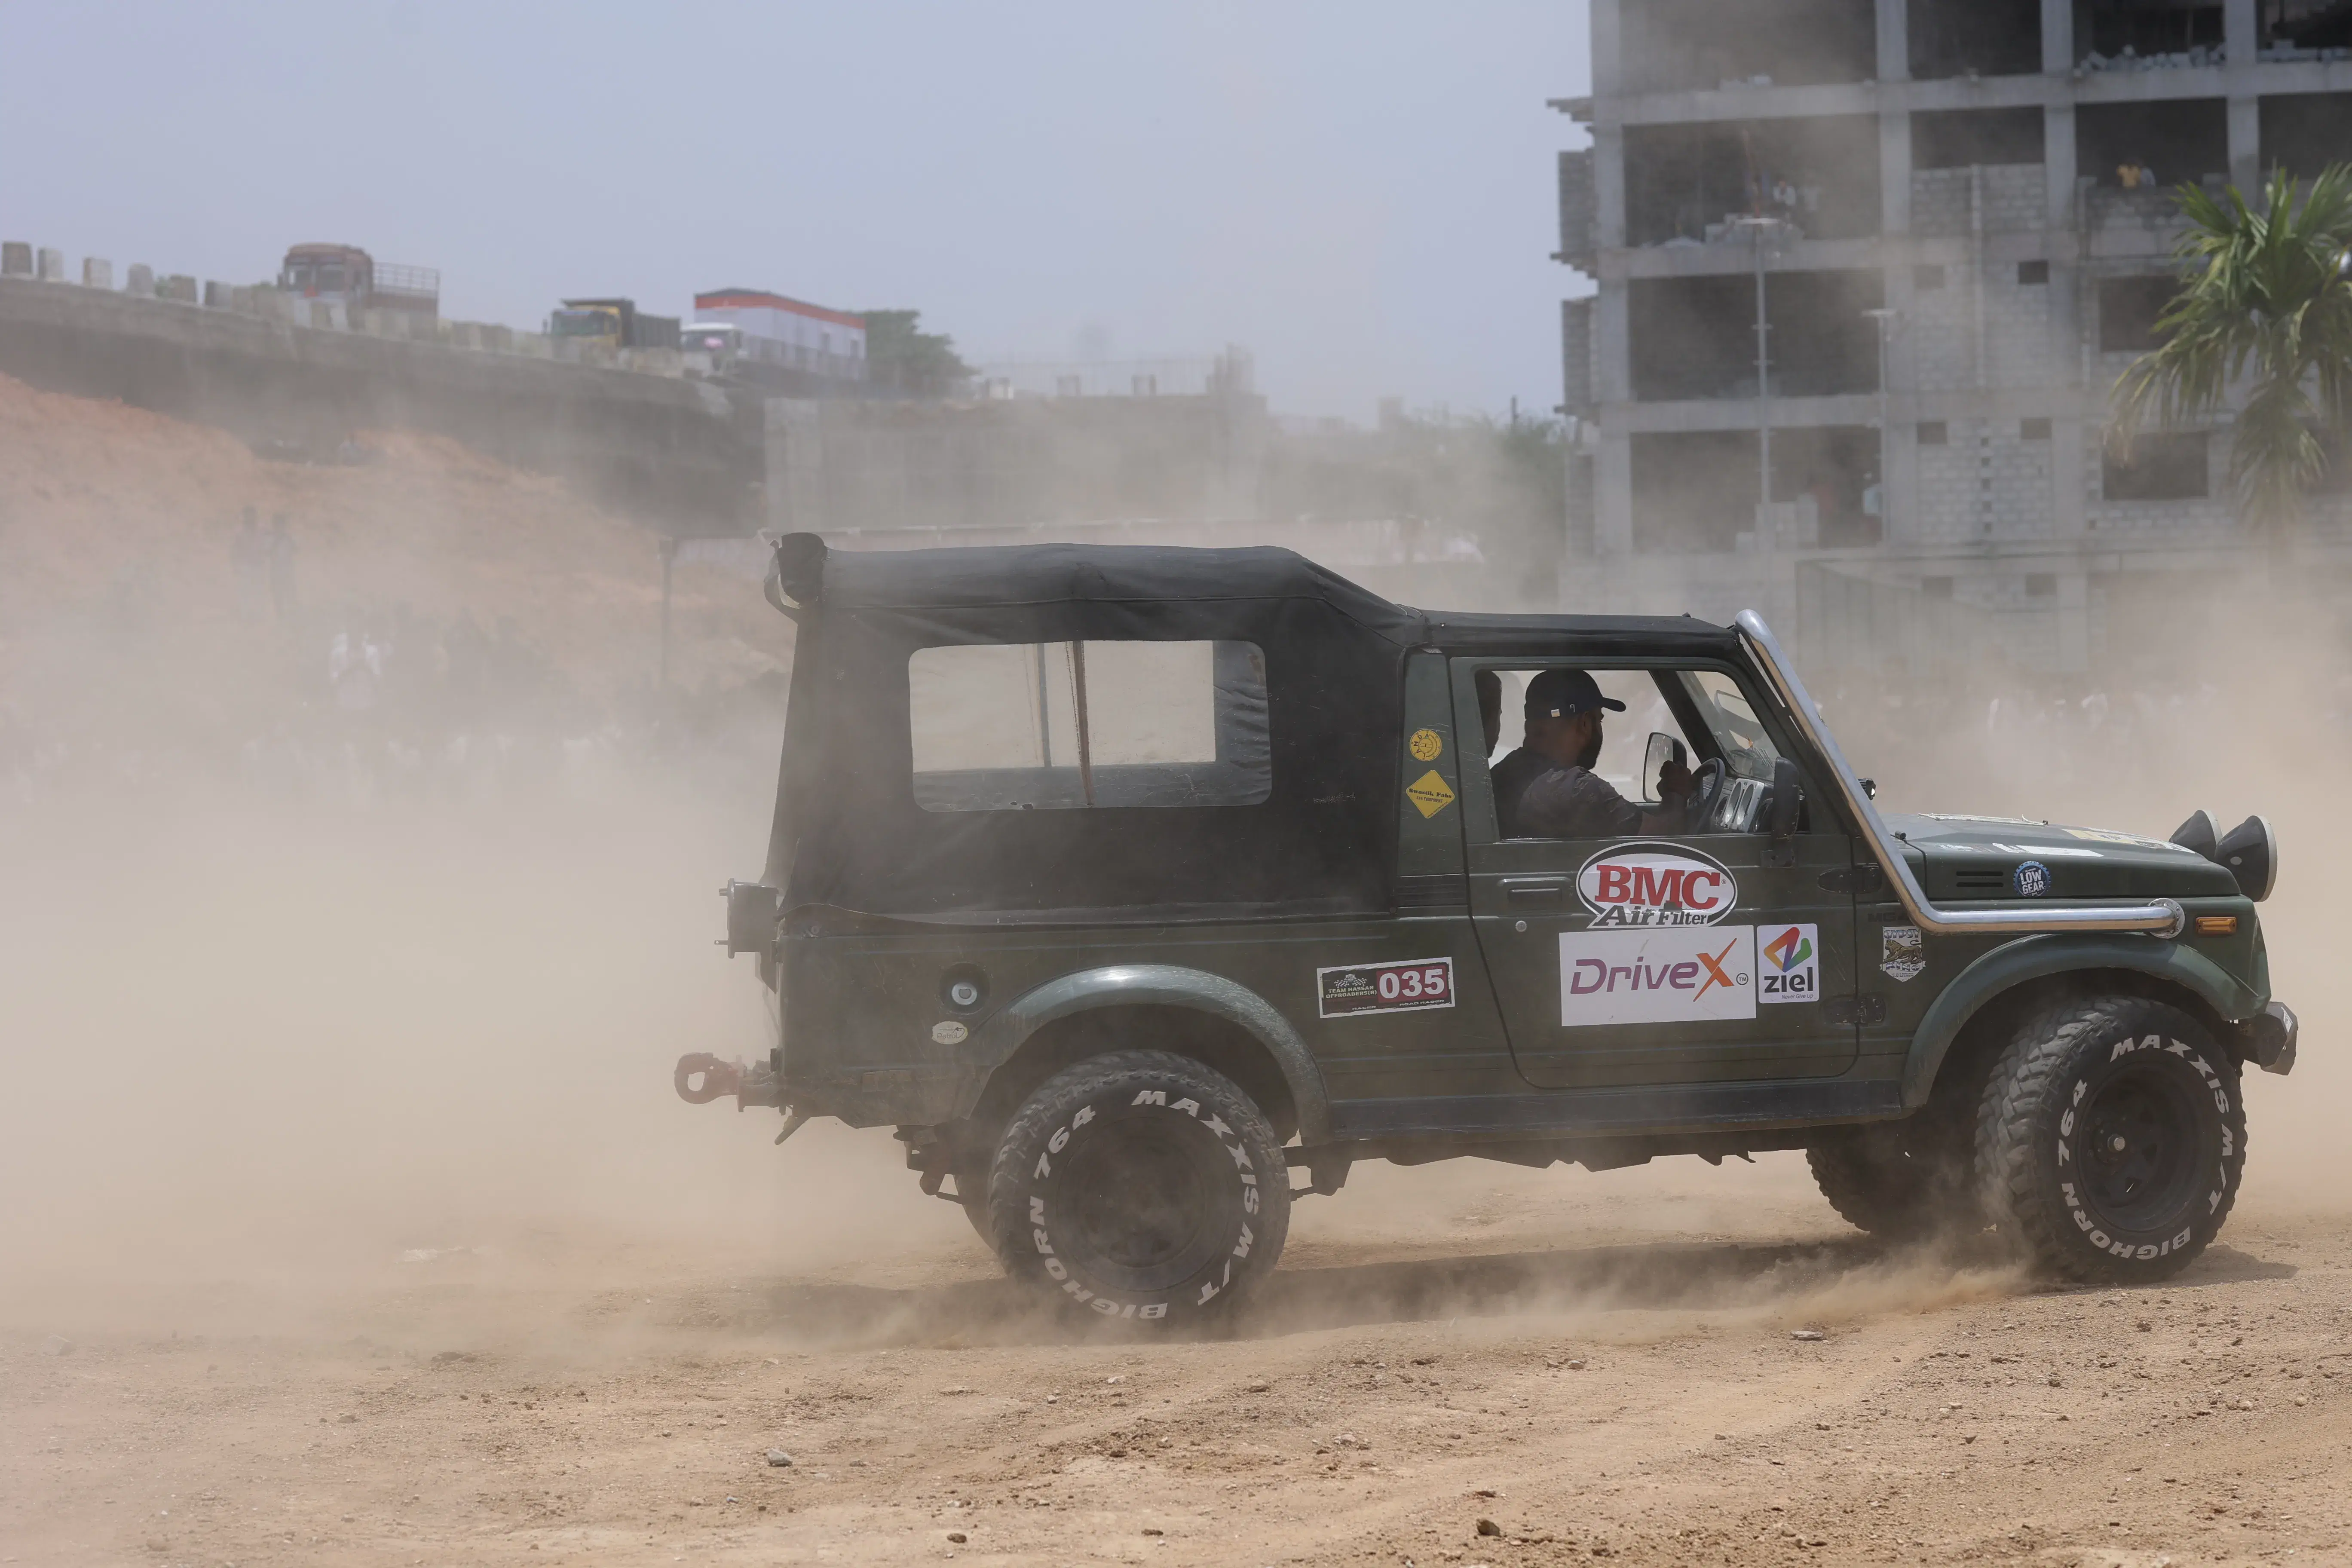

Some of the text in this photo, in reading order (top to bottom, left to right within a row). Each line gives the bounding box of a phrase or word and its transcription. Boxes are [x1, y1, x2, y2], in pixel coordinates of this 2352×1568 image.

[1409, 788, 1434, 796] Swastik
[1594, 864, 1721, 910] BMC
[2020, 869, 2041, 885] LOW
[2022, 880, 2045, 894] GEAR
[1592, 900, 1707, 926] Air Filter
[1883, 929, 1920, 939] GYPSY
[1570, 937, 1737, 1002] DriveX
[1764, 966, 1813, 993] ziel
[1886, 962, 1920, 971] KING
[1326, 990, 1377, 998] OFFROADERS(R)
[1379, 968, 1445, 998] 035
[2058, 1035, 2233, 1260] MAXXIS M/T BIGHORN 764
[1029, 1090, 1259, 1319] MAXXIS M/T BIGHORN 764
